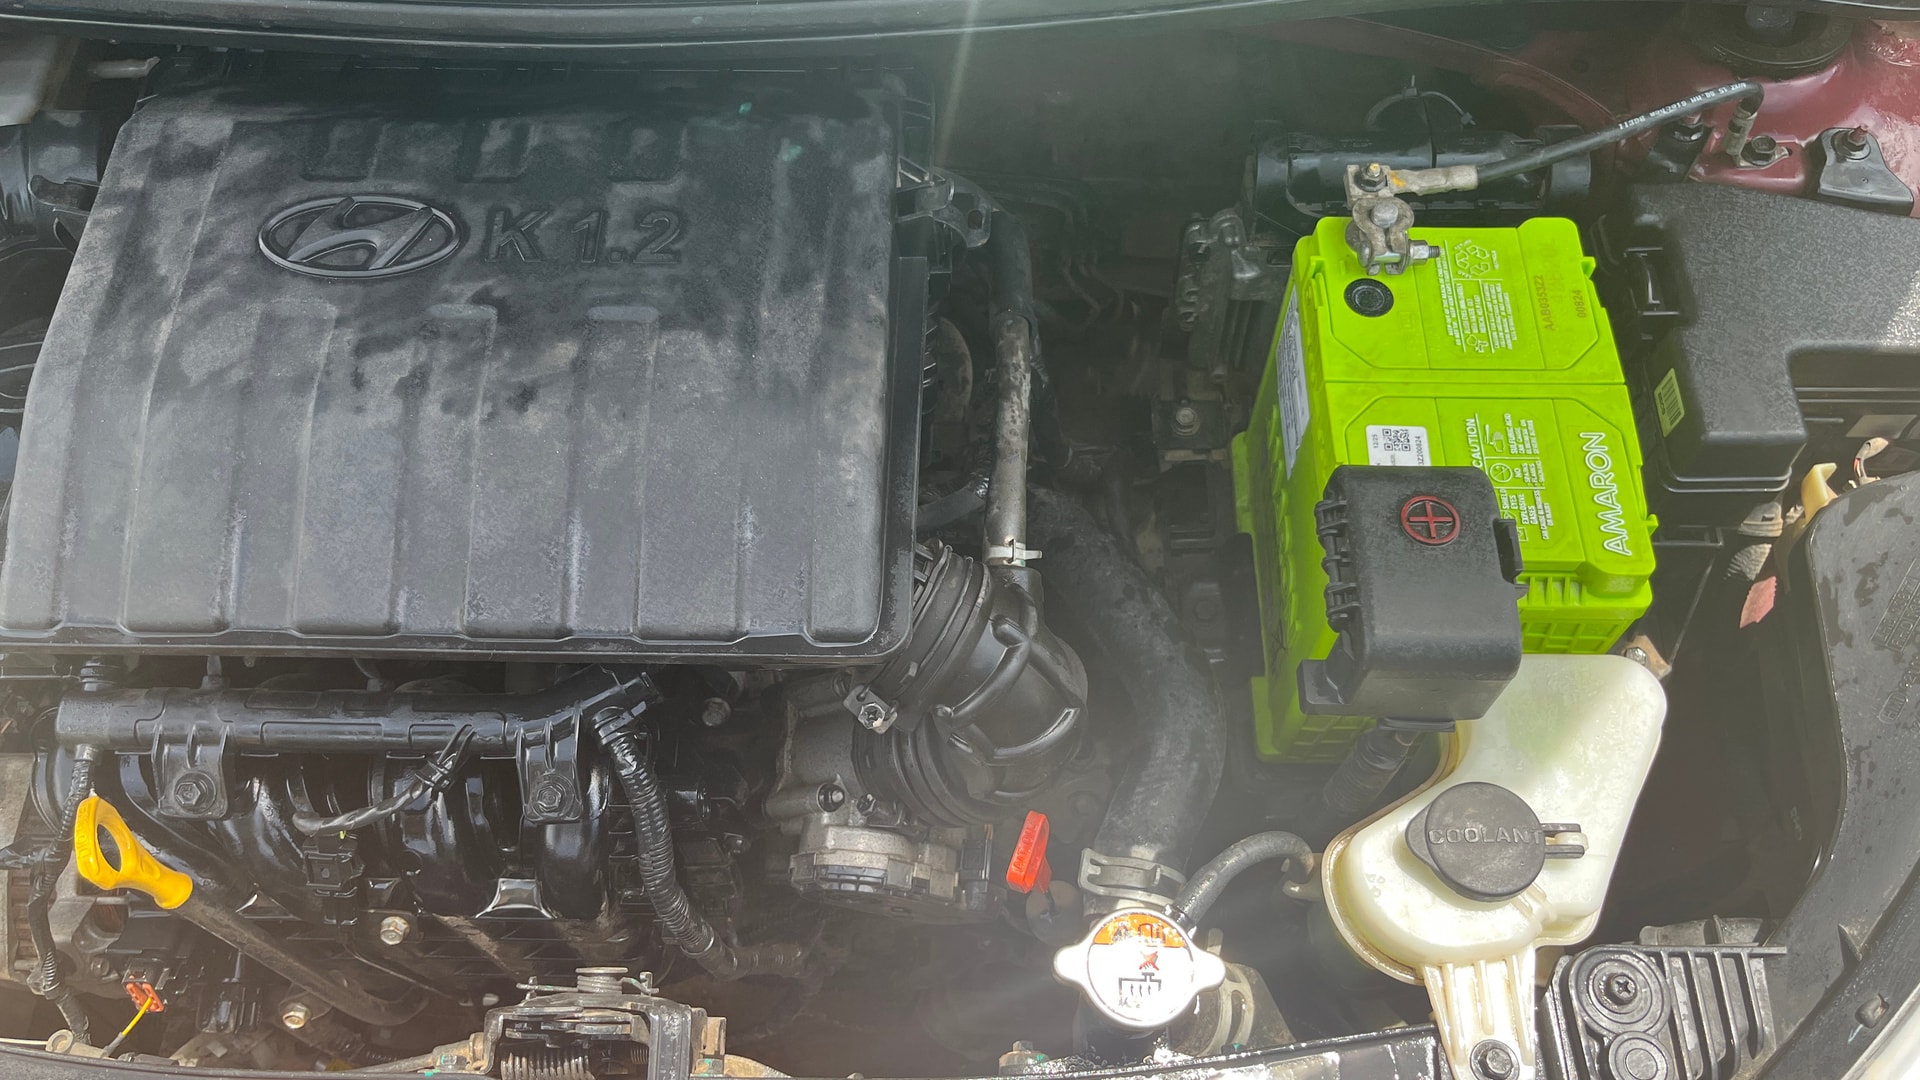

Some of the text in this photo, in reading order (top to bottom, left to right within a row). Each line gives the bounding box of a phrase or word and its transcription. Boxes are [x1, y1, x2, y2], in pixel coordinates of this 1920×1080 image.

[484, 210, 681, 264] K 1.2
[1572, 289, 1587, 318] 00824
[1466, 418, 1484, 468] CAUTION
[1514, 468, 1522, 478] NO
[1500, 488, 1510, 510] SHIELD
[1580, 432, 1632, 556] AMARON
[1517, 494, 1530, 525] EXPLOSIVE
[1528, 506, 1538, 525] GASES
[1428, 827, 1542, 844] COOLANT
